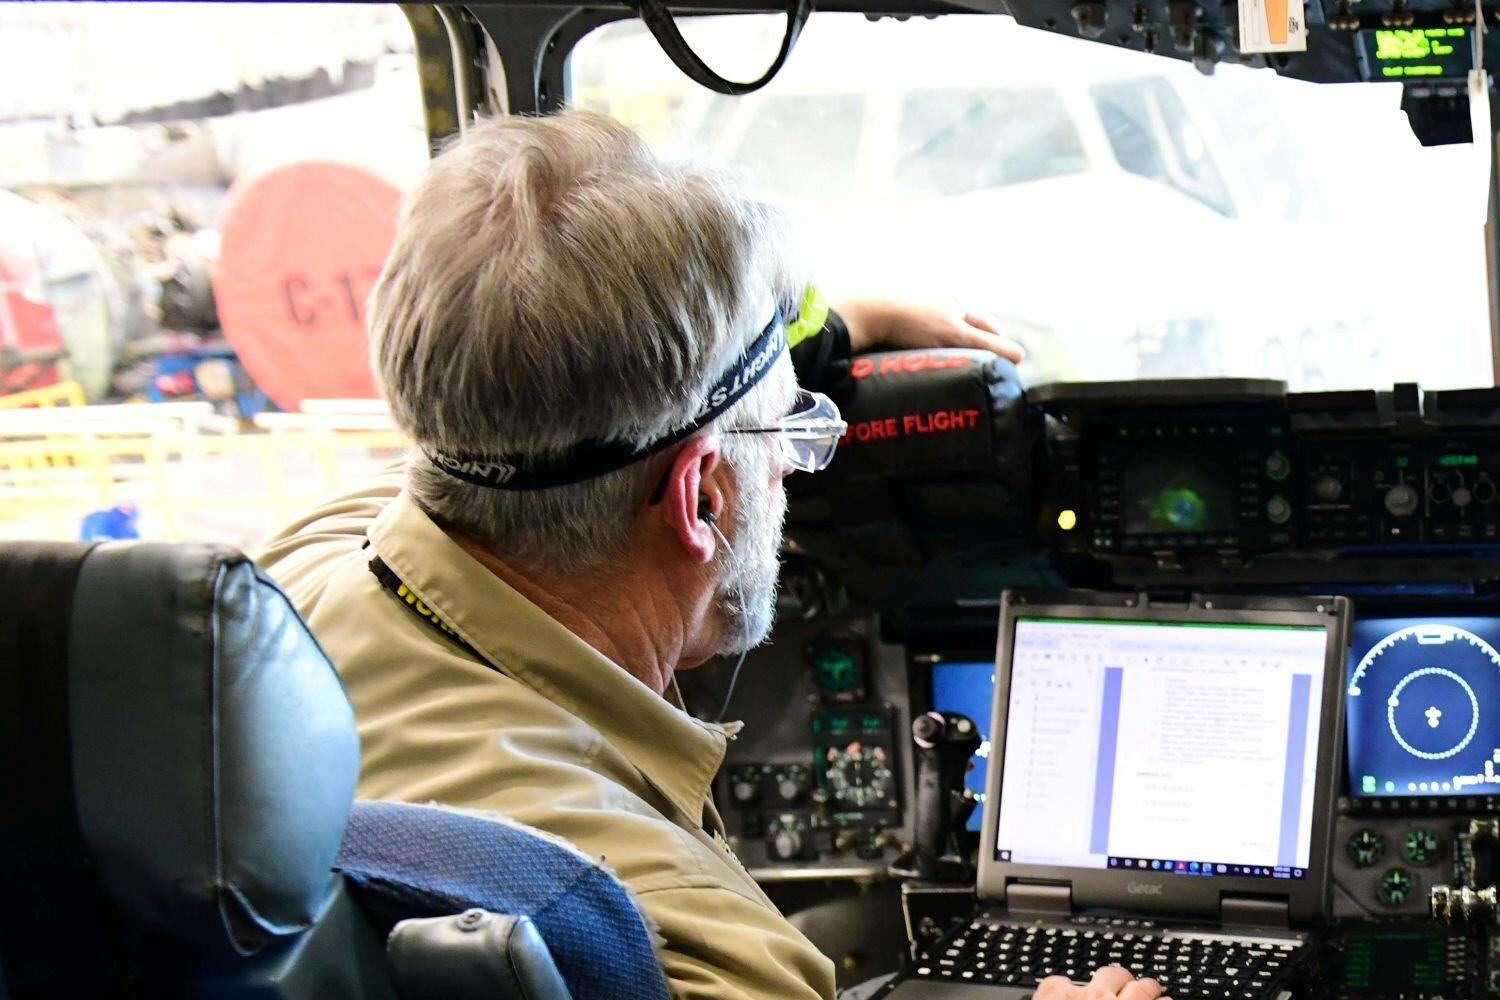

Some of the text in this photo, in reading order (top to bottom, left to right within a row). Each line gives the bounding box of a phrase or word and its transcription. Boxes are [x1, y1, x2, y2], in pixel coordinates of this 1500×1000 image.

[284, 272, 382, 325] C-1
[838, 409, 979, 448] FORE FLIGHT
[1127, 880, 1163, 895] Getac
